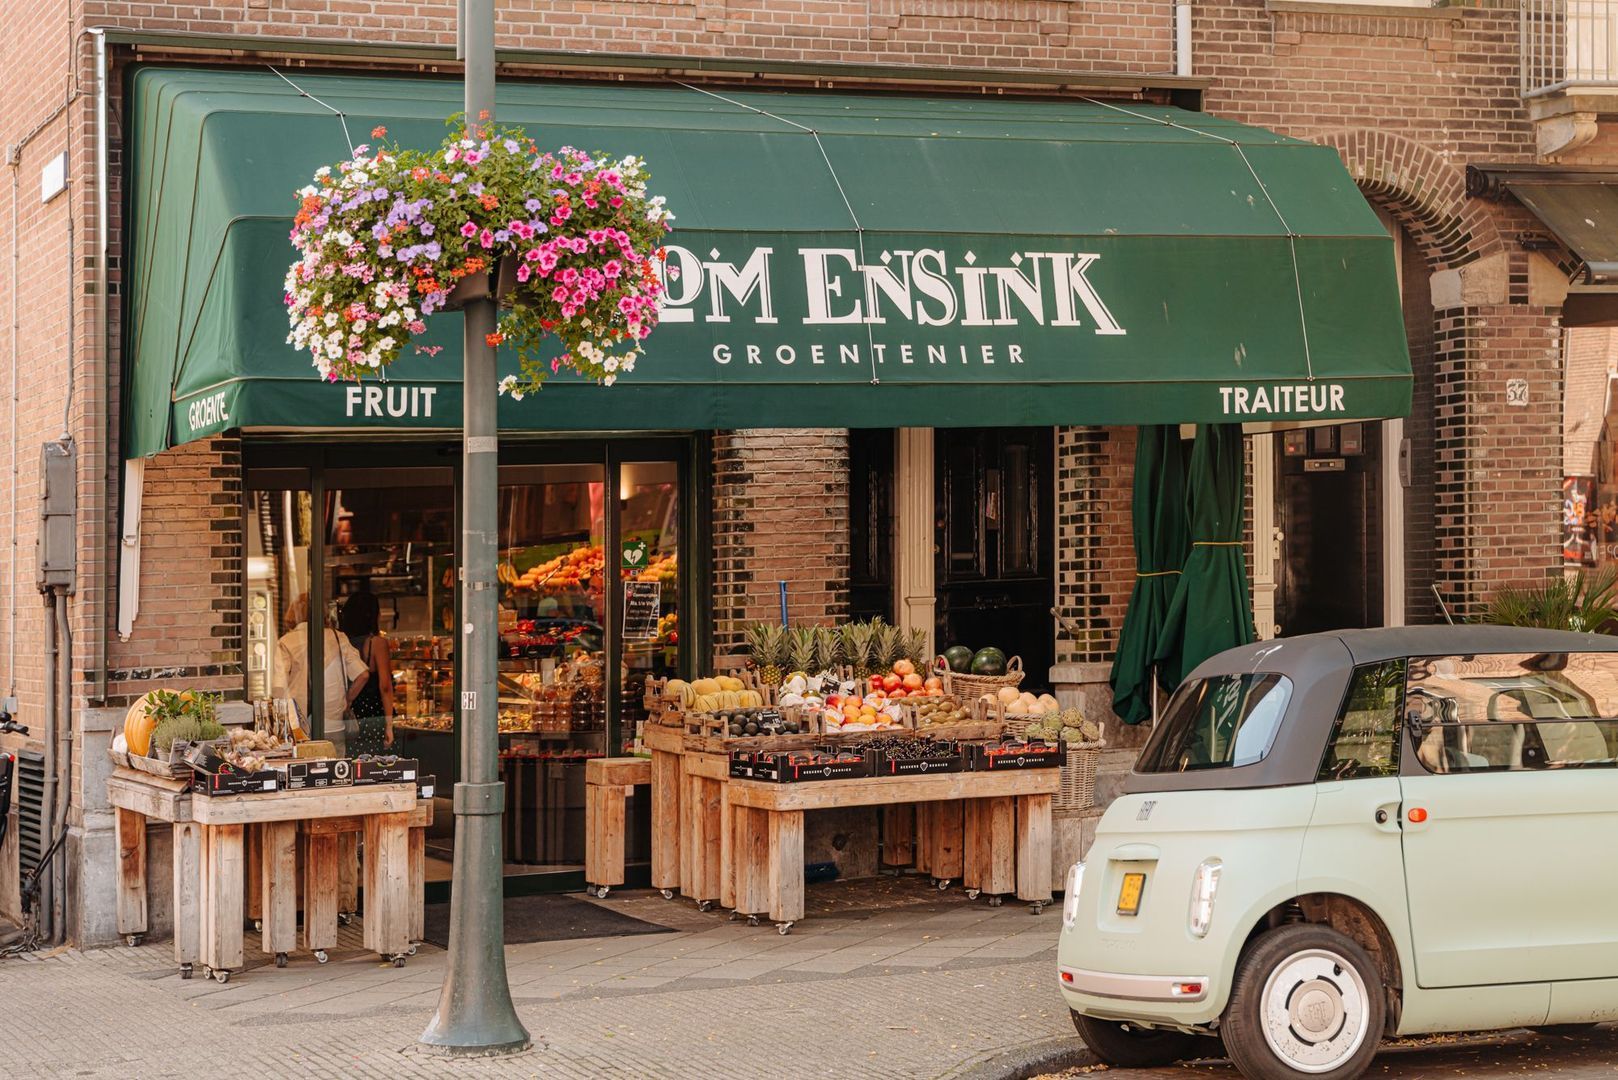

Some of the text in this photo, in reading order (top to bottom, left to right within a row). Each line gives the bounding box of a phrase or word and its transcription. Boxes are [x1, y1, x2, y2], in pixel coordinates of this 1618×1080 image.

[648, 245, 1127, 335] OM ENSINK
[712, 343, 1024, 365] GROENTENIER
[188, 391, 230, 432] GROENTE
[346, 386, 437, 417] FRUIT
[1219, 384, 1345, 414] TRAITEUR
